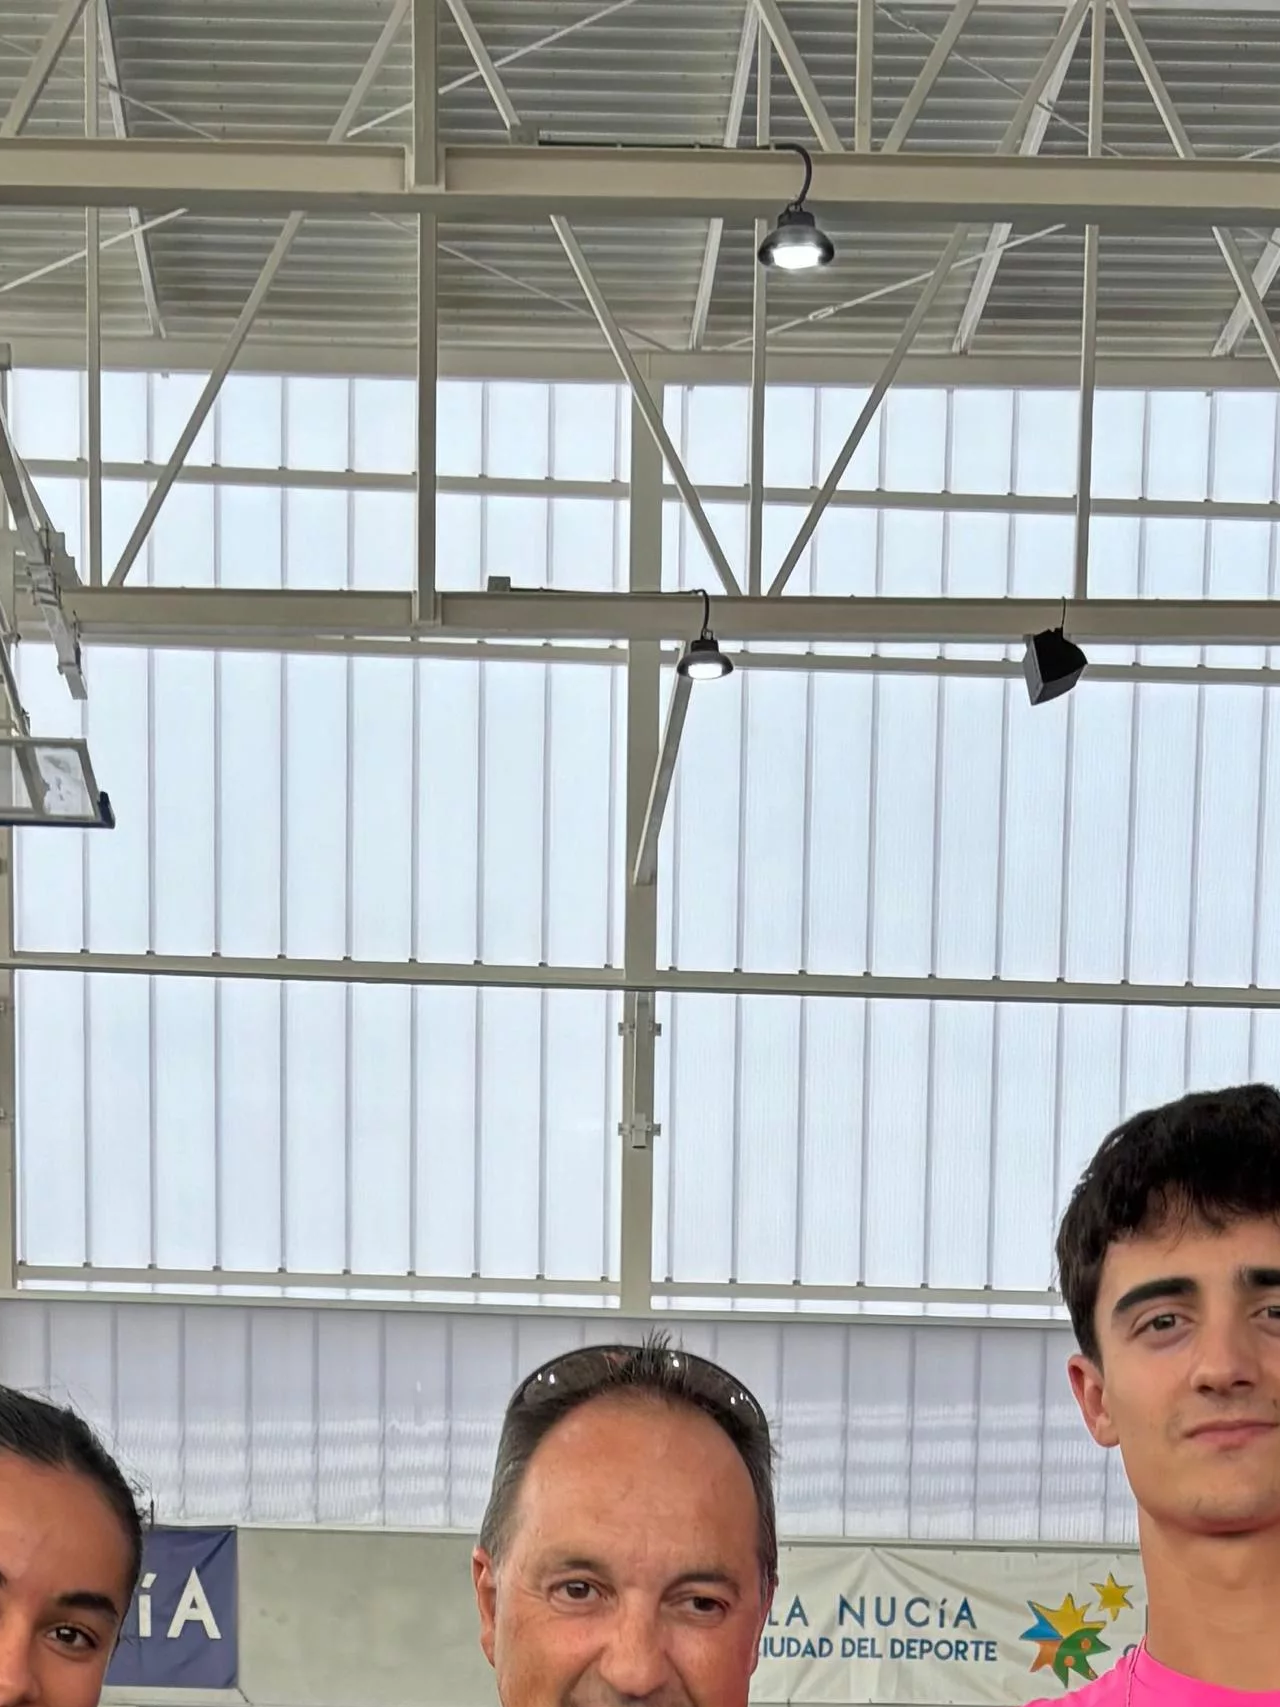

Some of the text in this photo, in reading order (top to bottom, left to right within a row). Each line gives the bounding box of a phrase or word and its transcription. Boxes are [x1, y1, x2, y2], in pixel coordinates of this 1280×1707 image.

[760, 1636, 998, 1662] IUDAD DEL DEPORTE
